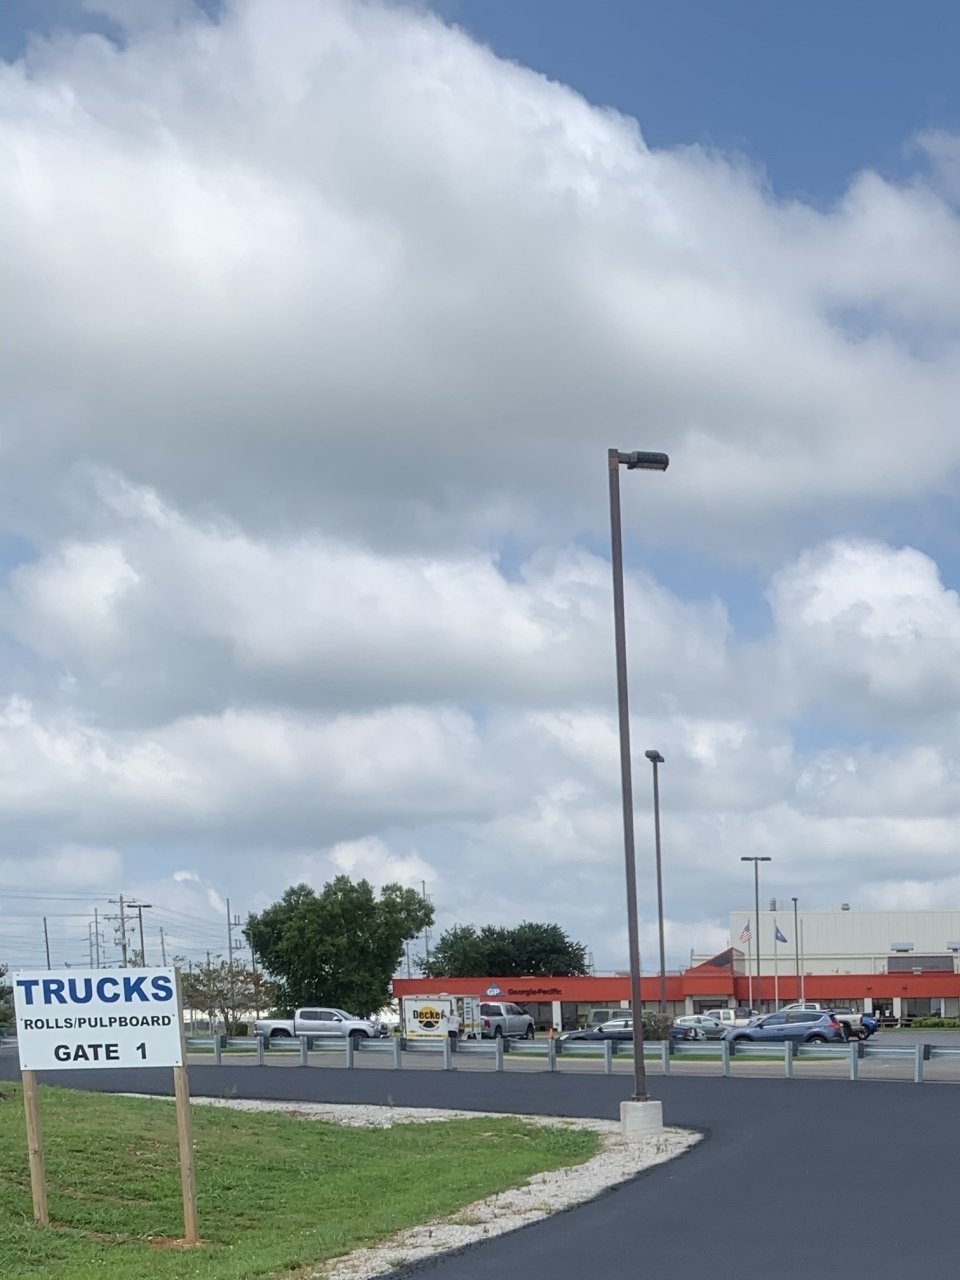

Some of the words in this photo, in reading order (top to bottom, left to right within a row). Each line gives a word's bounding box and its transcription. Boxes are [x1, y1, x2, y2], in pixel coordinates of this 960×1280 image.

[16, 975, 174, 1005] TRUCKS
[486, 988, 501, 996] GP
[24, 1016, 171, 1030] ROLLS/PULPBOARD
[54, 1043, 120, 1062] GATE
[136, 1042, 147, 1060] 1
